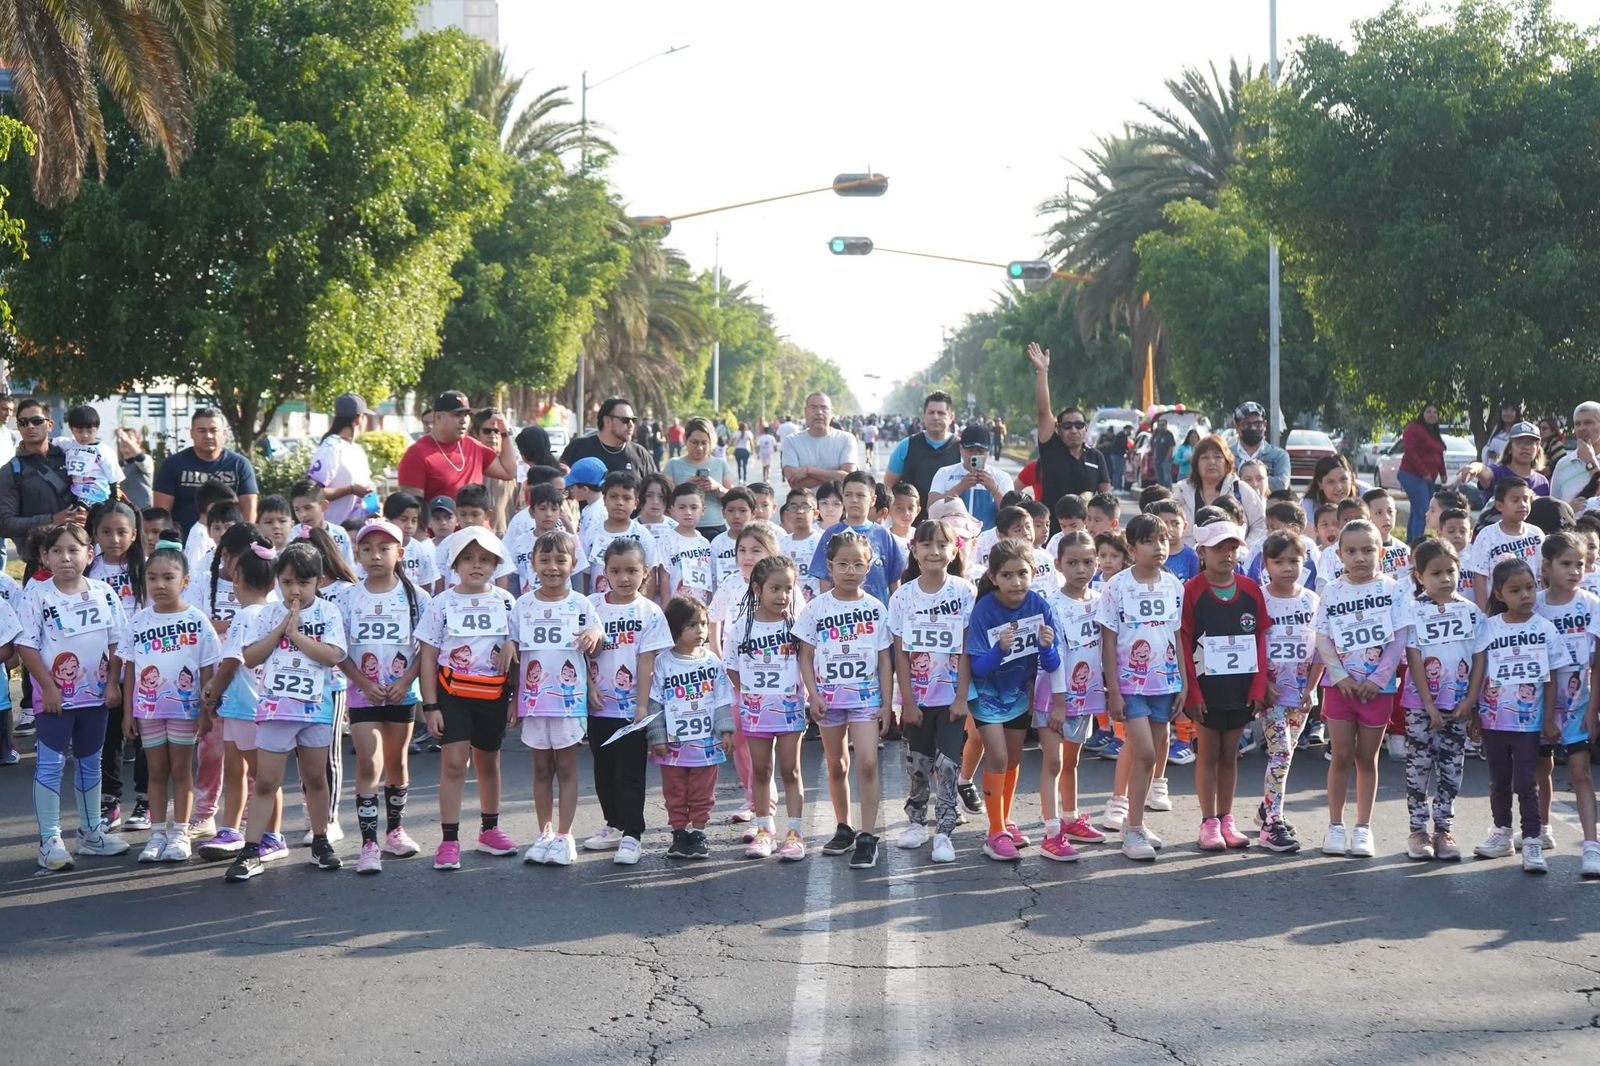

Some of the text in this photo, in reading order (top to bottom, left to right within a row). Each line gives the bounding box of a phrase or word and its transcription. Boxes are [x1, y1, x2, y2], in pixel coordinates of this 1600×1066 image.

[692, 571, 706, 584] 54
[798, 564, 808, 576] 8
[212, 608, 236, 621] 52
[1140, 599, 1165, 616] 89
[76, 607, 102, 627] 72
[462, 614, 492, 630] 48
[358, 622, 400, 640] 292
[533, 626, 562, 644] 86
[607, 632, 635, 645] TAS
[821, 622, 875, 642] POETAS
[839, 634, 858, 643] 2025
[912, 629, 953, 647] 159
[1341, 625, 1386, 648] 306
[1425, 620, 1465, 640] 572
[144, 633, 198, 655] POETAS
[161, 645, 181, 653] 2025
[601, 643, 619, 651] 2025
[1007, 633, 1038, 655] 34
[1486, 631, 1546, 651] QUEÑOS
[1270, 643, 1308, 659] 236
[1227, 653, 1239, 669] 2
[664, 666, 718, 689] EQUEÑO
[754, 671, 780, 688] 32
[827, 661, 867, 680] 502
[1497, 661, 1541, 680] 449
[272, 674, 315, 695] 523
[685, 692, 704, 701] 2025
[675, 716, 712, 737] 299
